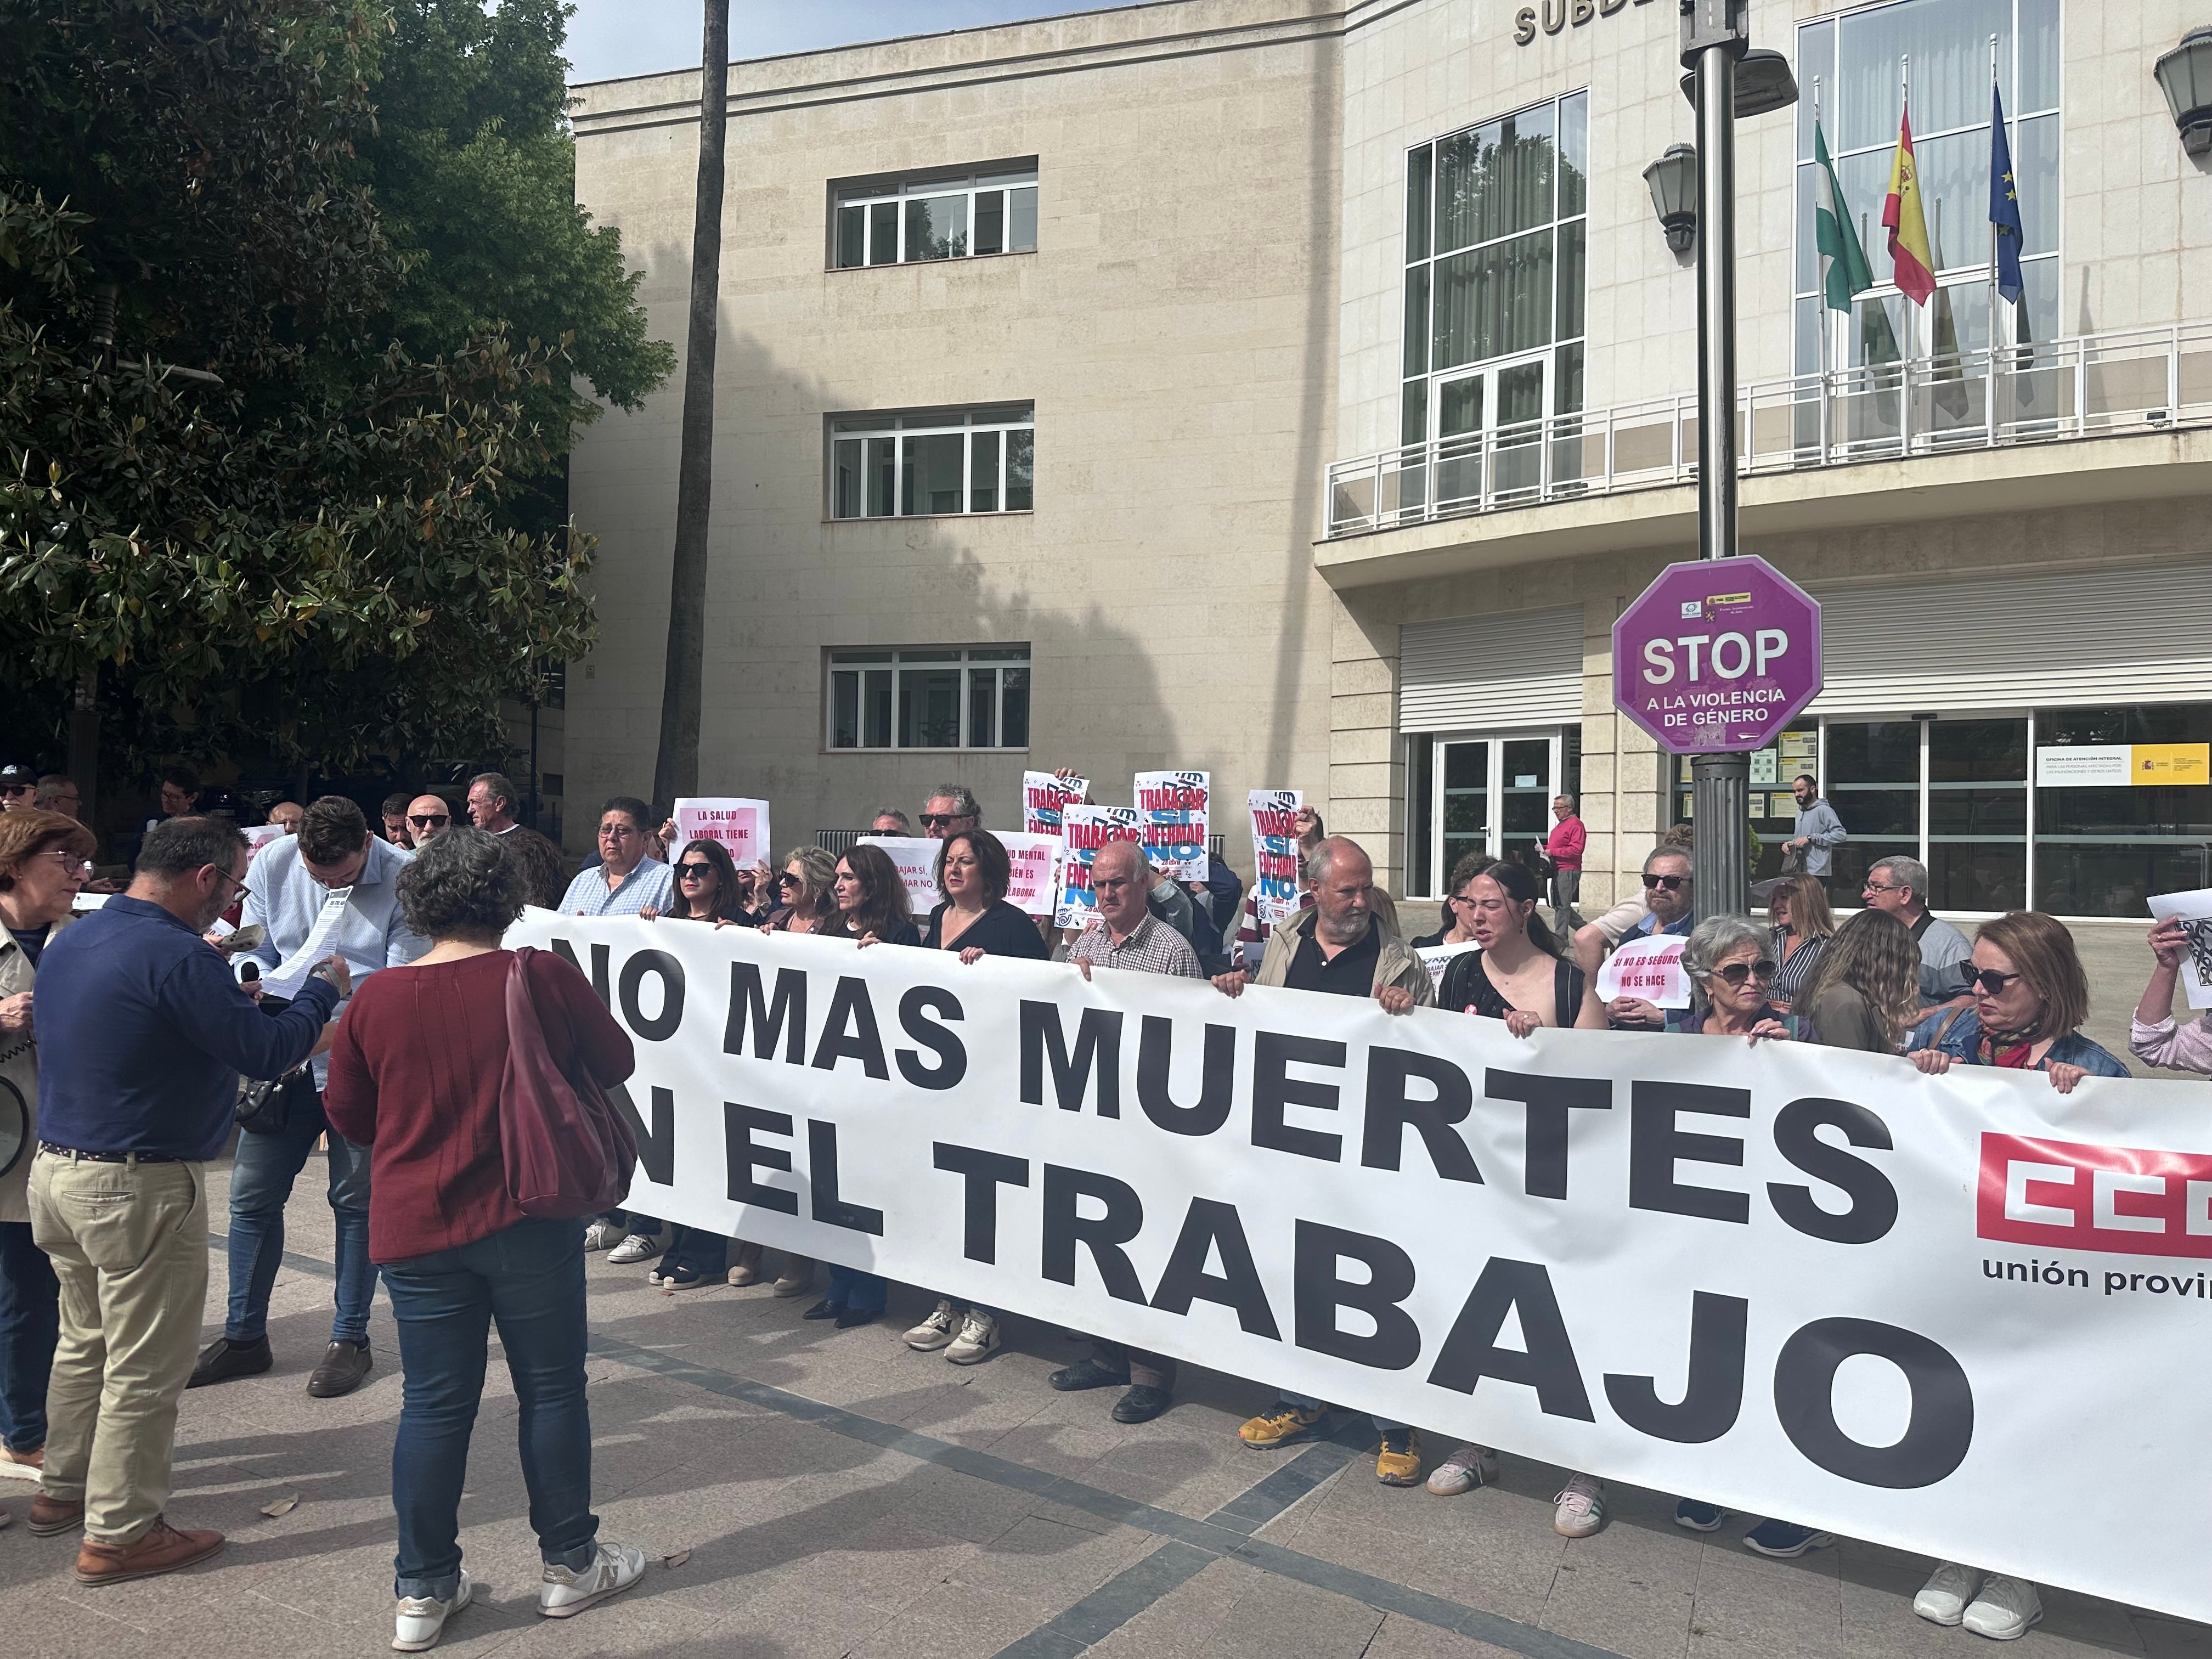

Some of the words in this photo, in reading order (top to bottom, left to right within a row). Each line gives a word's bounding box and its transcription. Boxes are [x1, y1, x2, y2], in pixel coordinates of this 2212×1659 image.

[1643, 629, 1788, 685] STOP
[1646, 697, 1660, 710] A
[1663, 695, 1685, 709] LA
[1690, 687, 1786, 708] VIOLENCIA
[1664, 713, 1688, 727] DE
[1692, 707, 1769, 725] GÉNERO
[1139, 788, 1205, 811] TRABAJAR
[697, 811, 707, 821] LA
[710, 811, 737, 820] SALUD
[689, 830, 724, 839] LABORAL
[726, 829, 748, 839] TIENE
[1142, 823, 1204, 847] ENFERMAR
[1018, 850, 1046, 861] MENTAL
[1143, 840, 1201, 861] NO
[894, 865, 918, 876] BAJAR
[918, 865, 928, 876] SÍ,
[1009, 866, 1023, 878] BIÉN
[1025, 869, 1034, 879] ES
[1259, 851, 1296, 884] ENFERMAR
[1008, 887, 1036, 897] LABORAL
[1064, 882, 1097, 907] N
[1260, 872, 1295, 900] NO
[1614, 958, 1623, 967] SI
[1623, 957, 1634, 967] NO
[1635, 956, 1646, 966] ES
[1647, 955, 1679, 966] SEGURO,
[1621, 976, 1631, 987] NO
[1634, 975, 1643, 986] SE
[1646, 975, 1665, 986] HACE
[723, 961, 967, 1091] MAS
[1019, 999, 1899, 1244] MUERTES
[604, 1083, 675, 1187] N
[724, 1102, 884, 1237] EL
[933, 1141, 1974, 1489] TRABAJO
[1983, 1259, 2089, 1288] unión
[2104, 1271, 2212, 1300] provi
